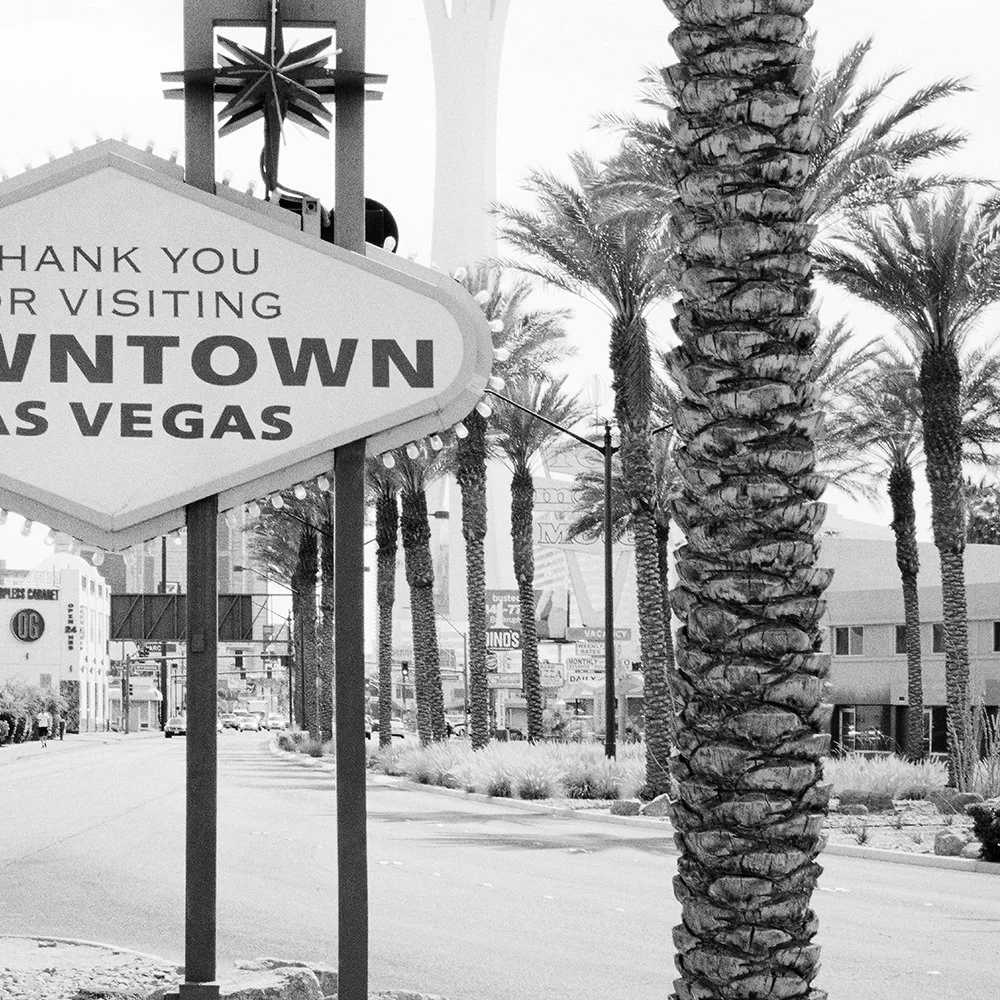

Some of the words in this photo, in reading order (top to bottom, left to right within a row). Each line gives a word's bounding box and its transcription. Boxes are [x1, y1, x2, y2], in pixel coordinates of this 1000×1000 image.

[161, 246, 261, 275] YOU
[59, 287, 283, 319] VISITING
[69, 402, 293, 441] VEGAS
[27, 588, 60, 600] CABARET
[17, 612, 40, 640] OG
[64, 626, 77, 634] 24
[584, 629, 627, 638] VACCY
